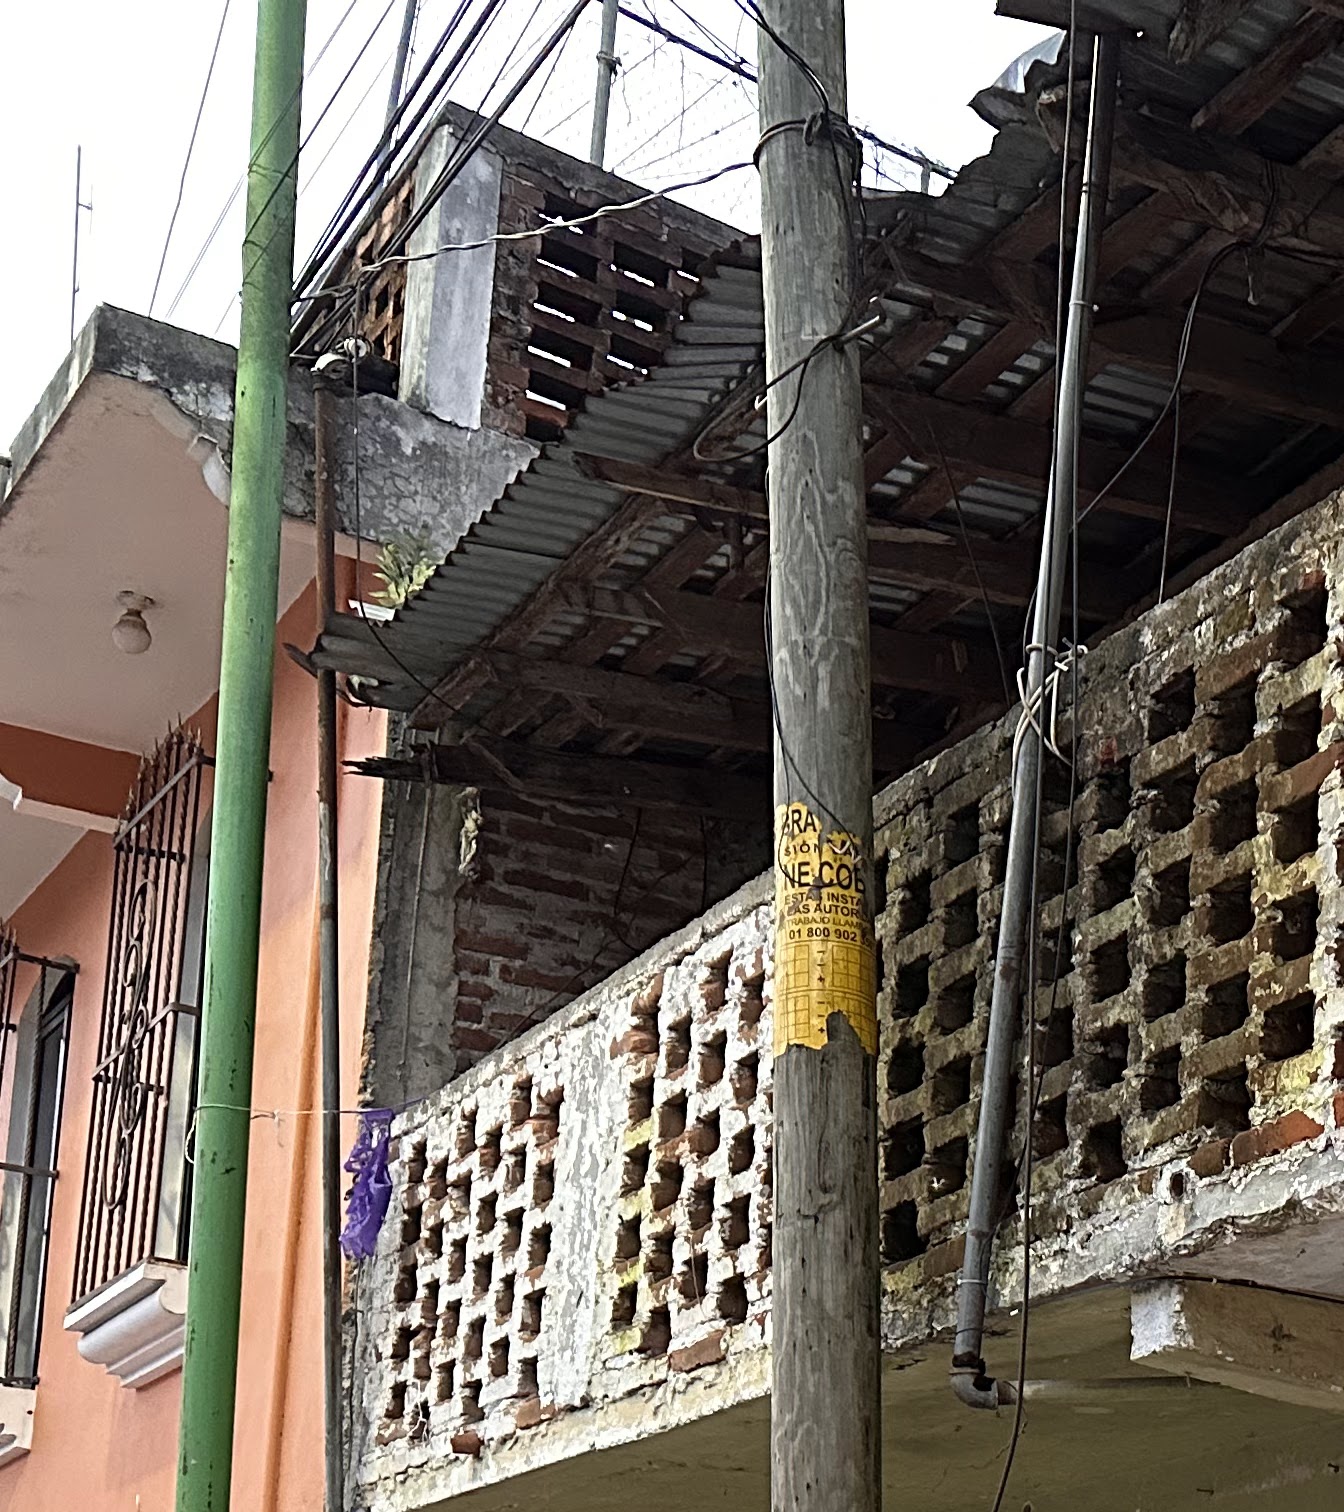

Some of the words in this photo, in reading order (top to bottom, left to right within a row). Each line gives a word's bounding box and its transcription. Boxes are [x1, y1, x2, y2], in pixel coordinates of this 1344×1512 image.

[789, 928, 802, 940] 01
[807, 927, 830, 938] 800
[834, 928, 858, 942] 902
